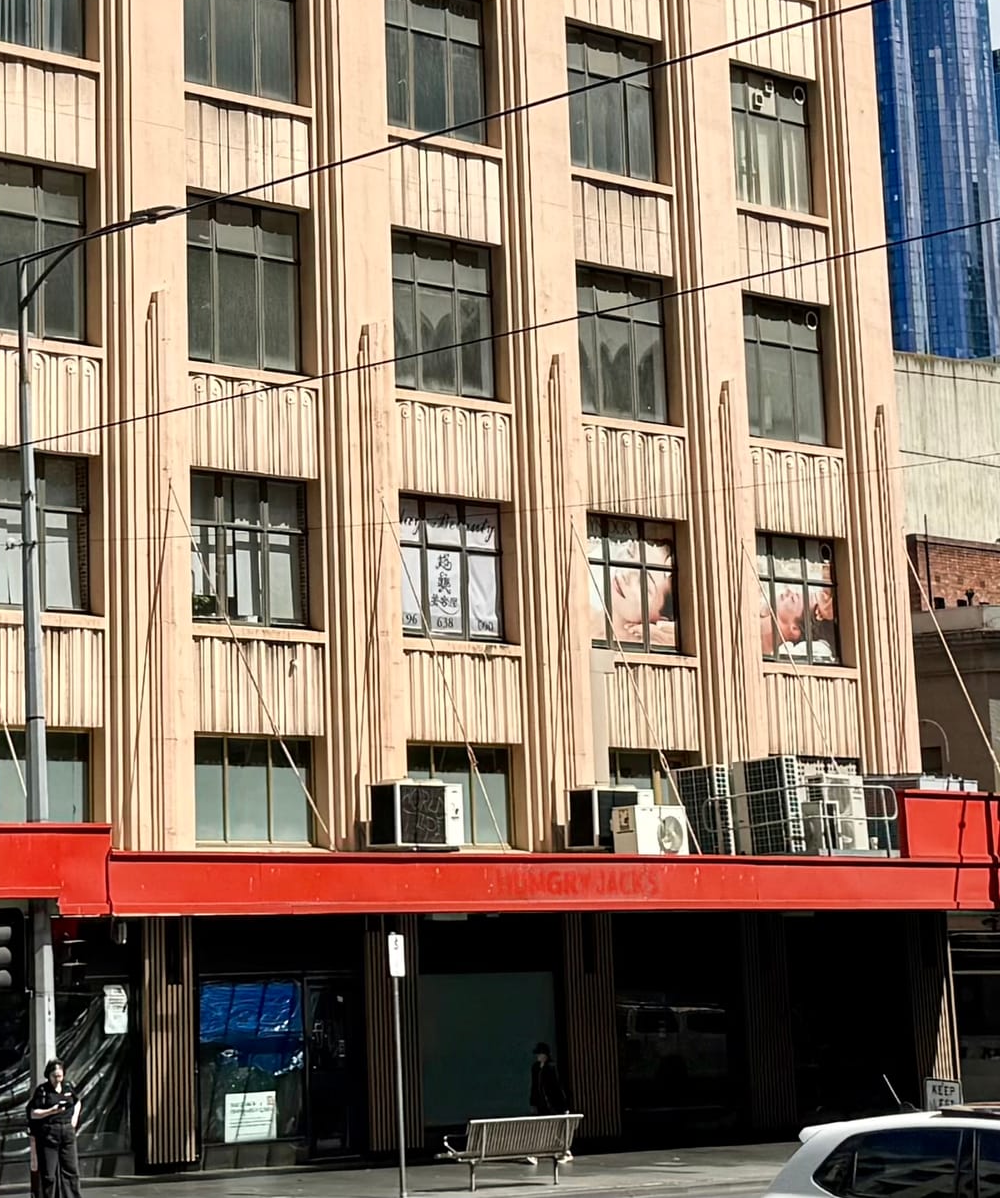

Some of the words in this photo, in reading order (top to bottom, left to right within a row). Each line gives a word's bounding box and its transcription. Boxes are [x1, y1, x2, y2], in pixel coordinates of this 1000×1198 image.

[436, 617, 454, 629] 638
[497, 868, 590, 895] HUNGRY
[932, 1084, 956, 1096] KEEP
